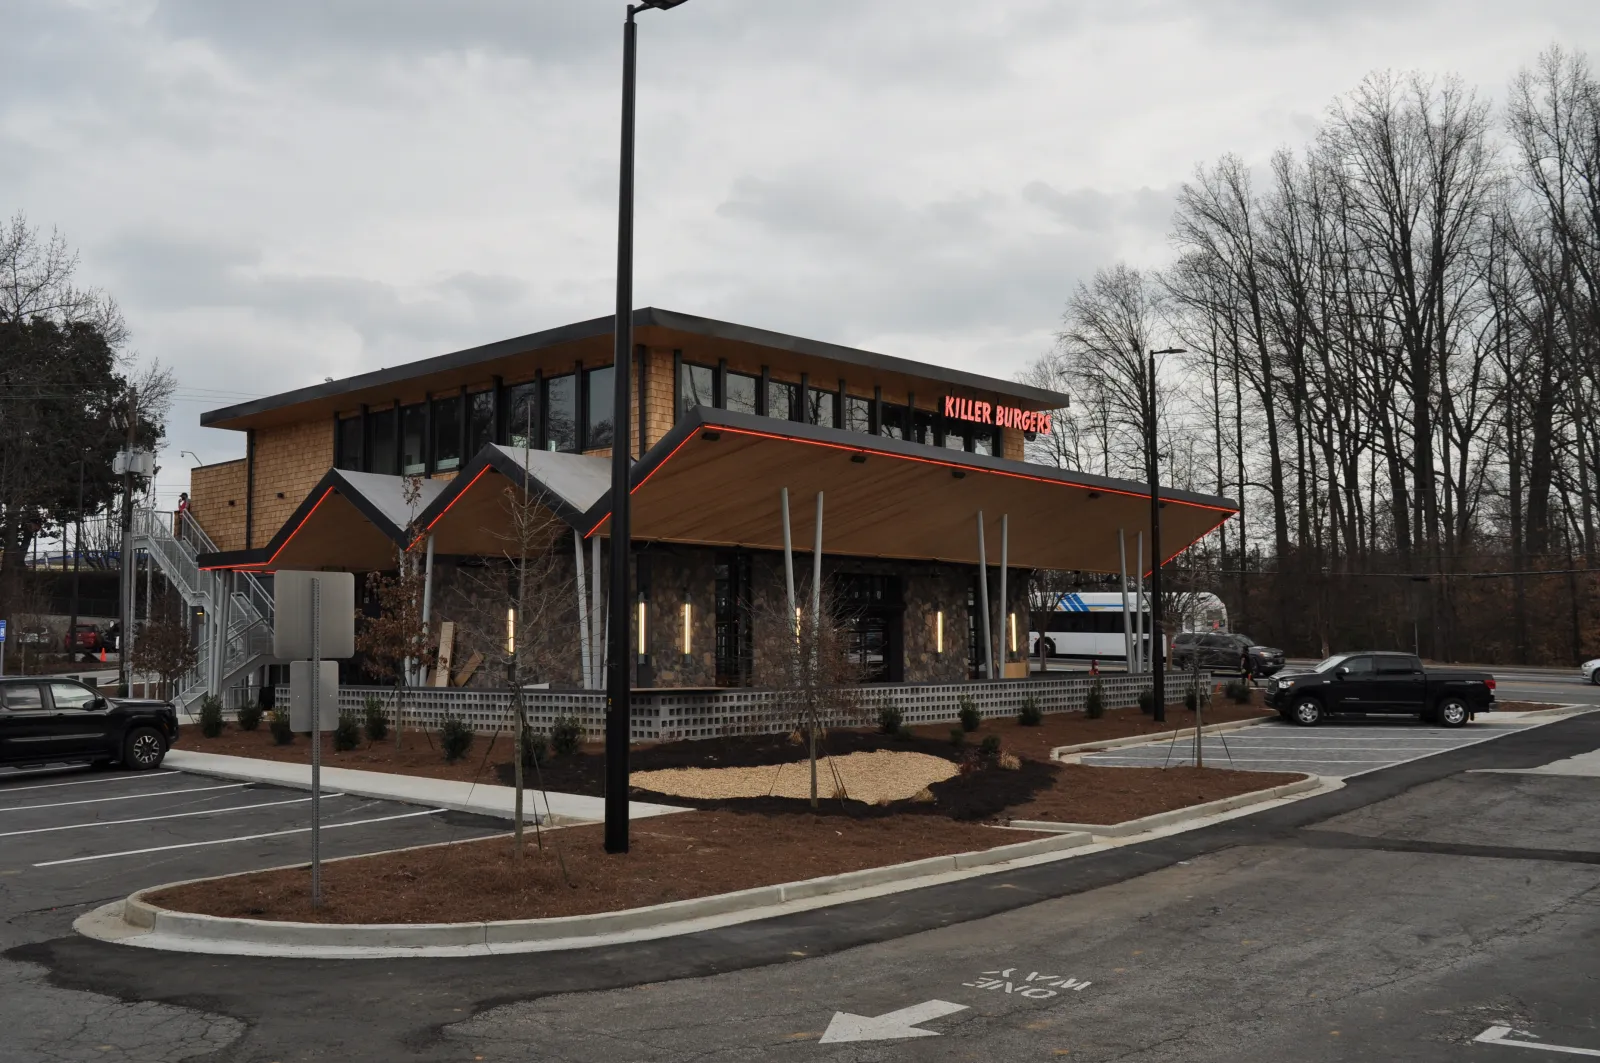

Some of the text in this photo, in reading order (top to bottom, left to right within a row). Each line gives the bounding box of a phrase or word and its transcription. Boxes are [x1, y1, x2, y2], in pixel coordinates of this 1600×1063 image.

[945, 395, 1052, 434] KILLER BURGERS
[962, 977, 1058, 998] ONE
[981, 968, 1093, 991] WAY
